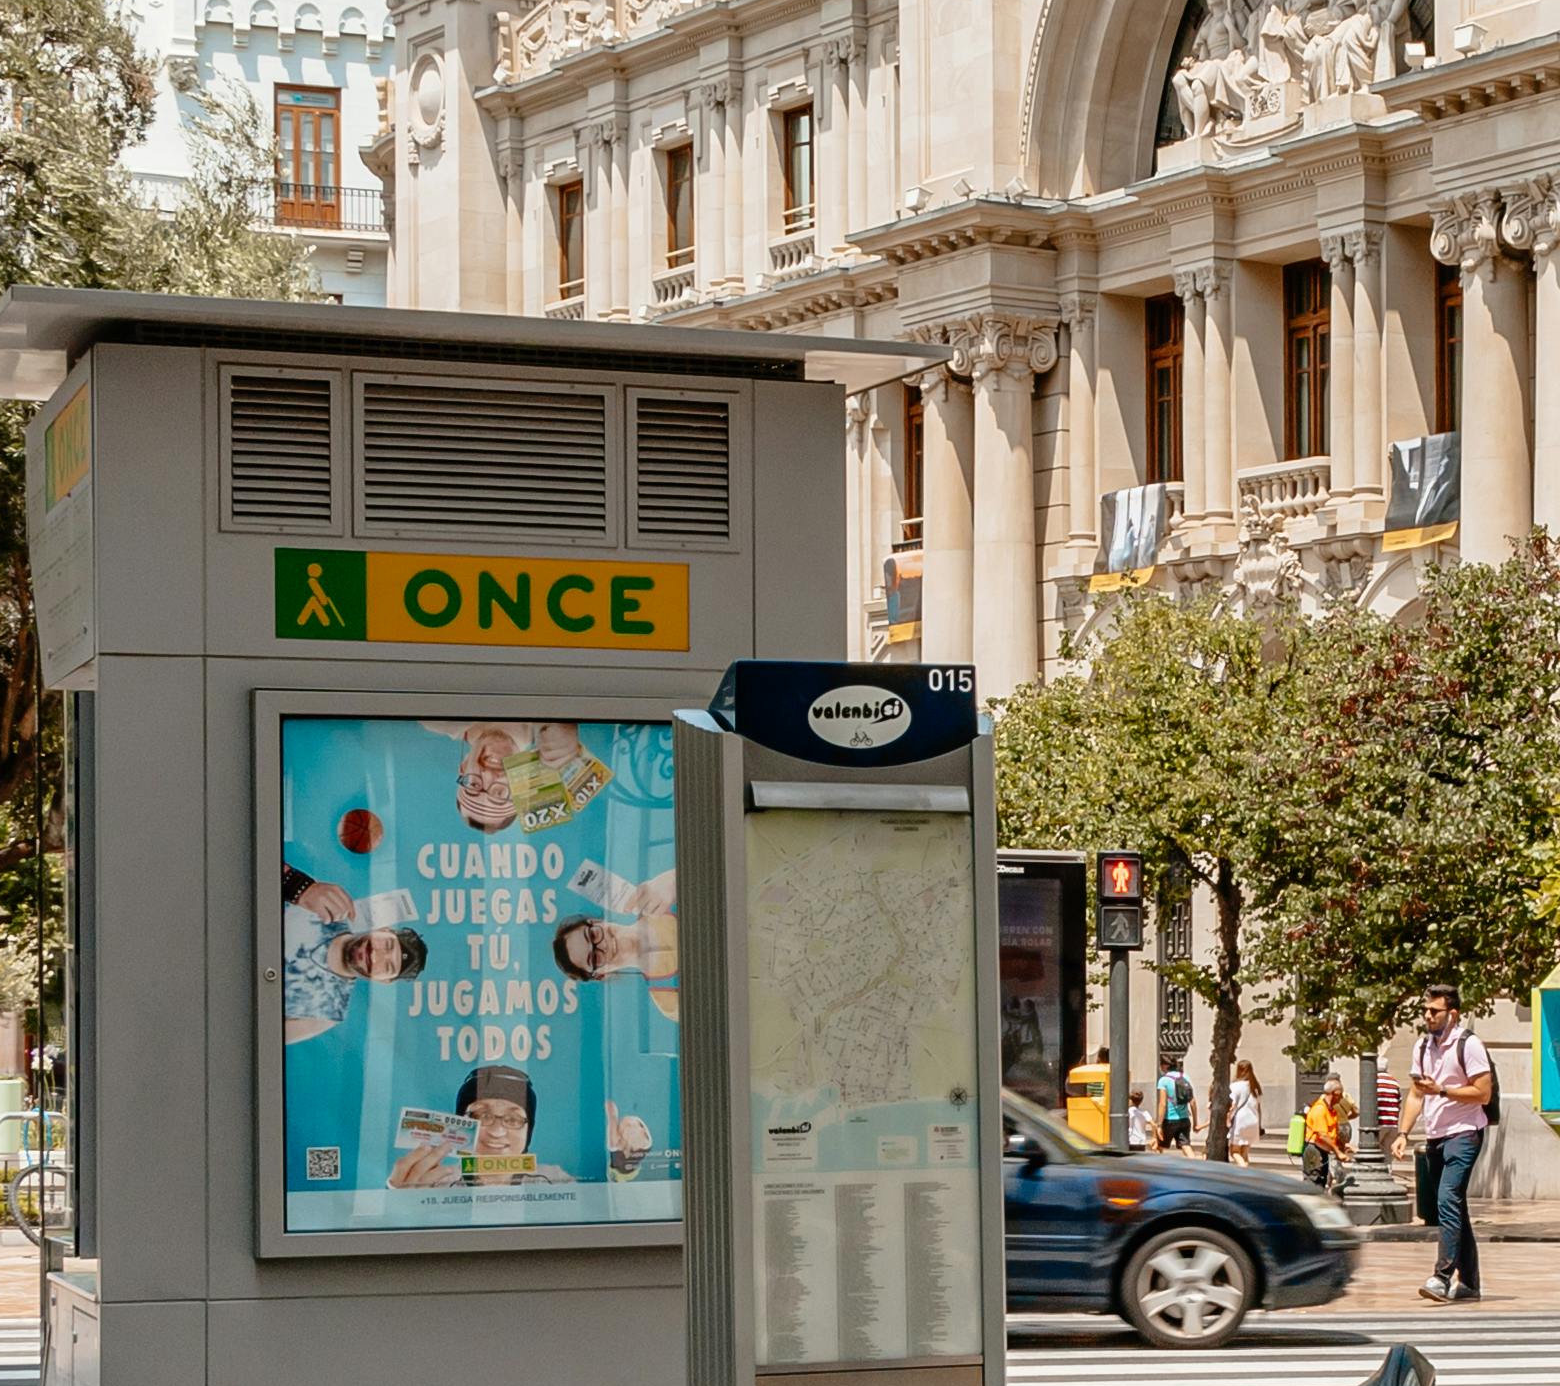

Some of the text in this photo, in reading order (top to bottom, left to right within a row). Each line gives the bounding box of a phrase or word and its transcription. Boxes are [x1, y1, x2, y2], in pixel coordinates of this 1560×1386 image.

[403, 568, 655, 637] ONCE
[928, 668, 973, 693] 015
[812, 698, 905, 721] valenbisi
[575, 773, 602, 805] X10
[523, 801, 570, 829] X20
[417, 843, 565, 880] CUANDO
[426, 887, 558, 925] JUEGAS
[467, 926, 521, 974] TÚ,
[408, 979, 579, 1017] JUGAMOS
[437, 1025, 552, 1062] TODOS
[483, 1158, 533, 1170] ONCE
[664, 1149, 682, 1157] ON
[442, 1195, 474, 1205] JUEGA
[476, 1192, 577, 1204] RESPONSABLEMENTE
